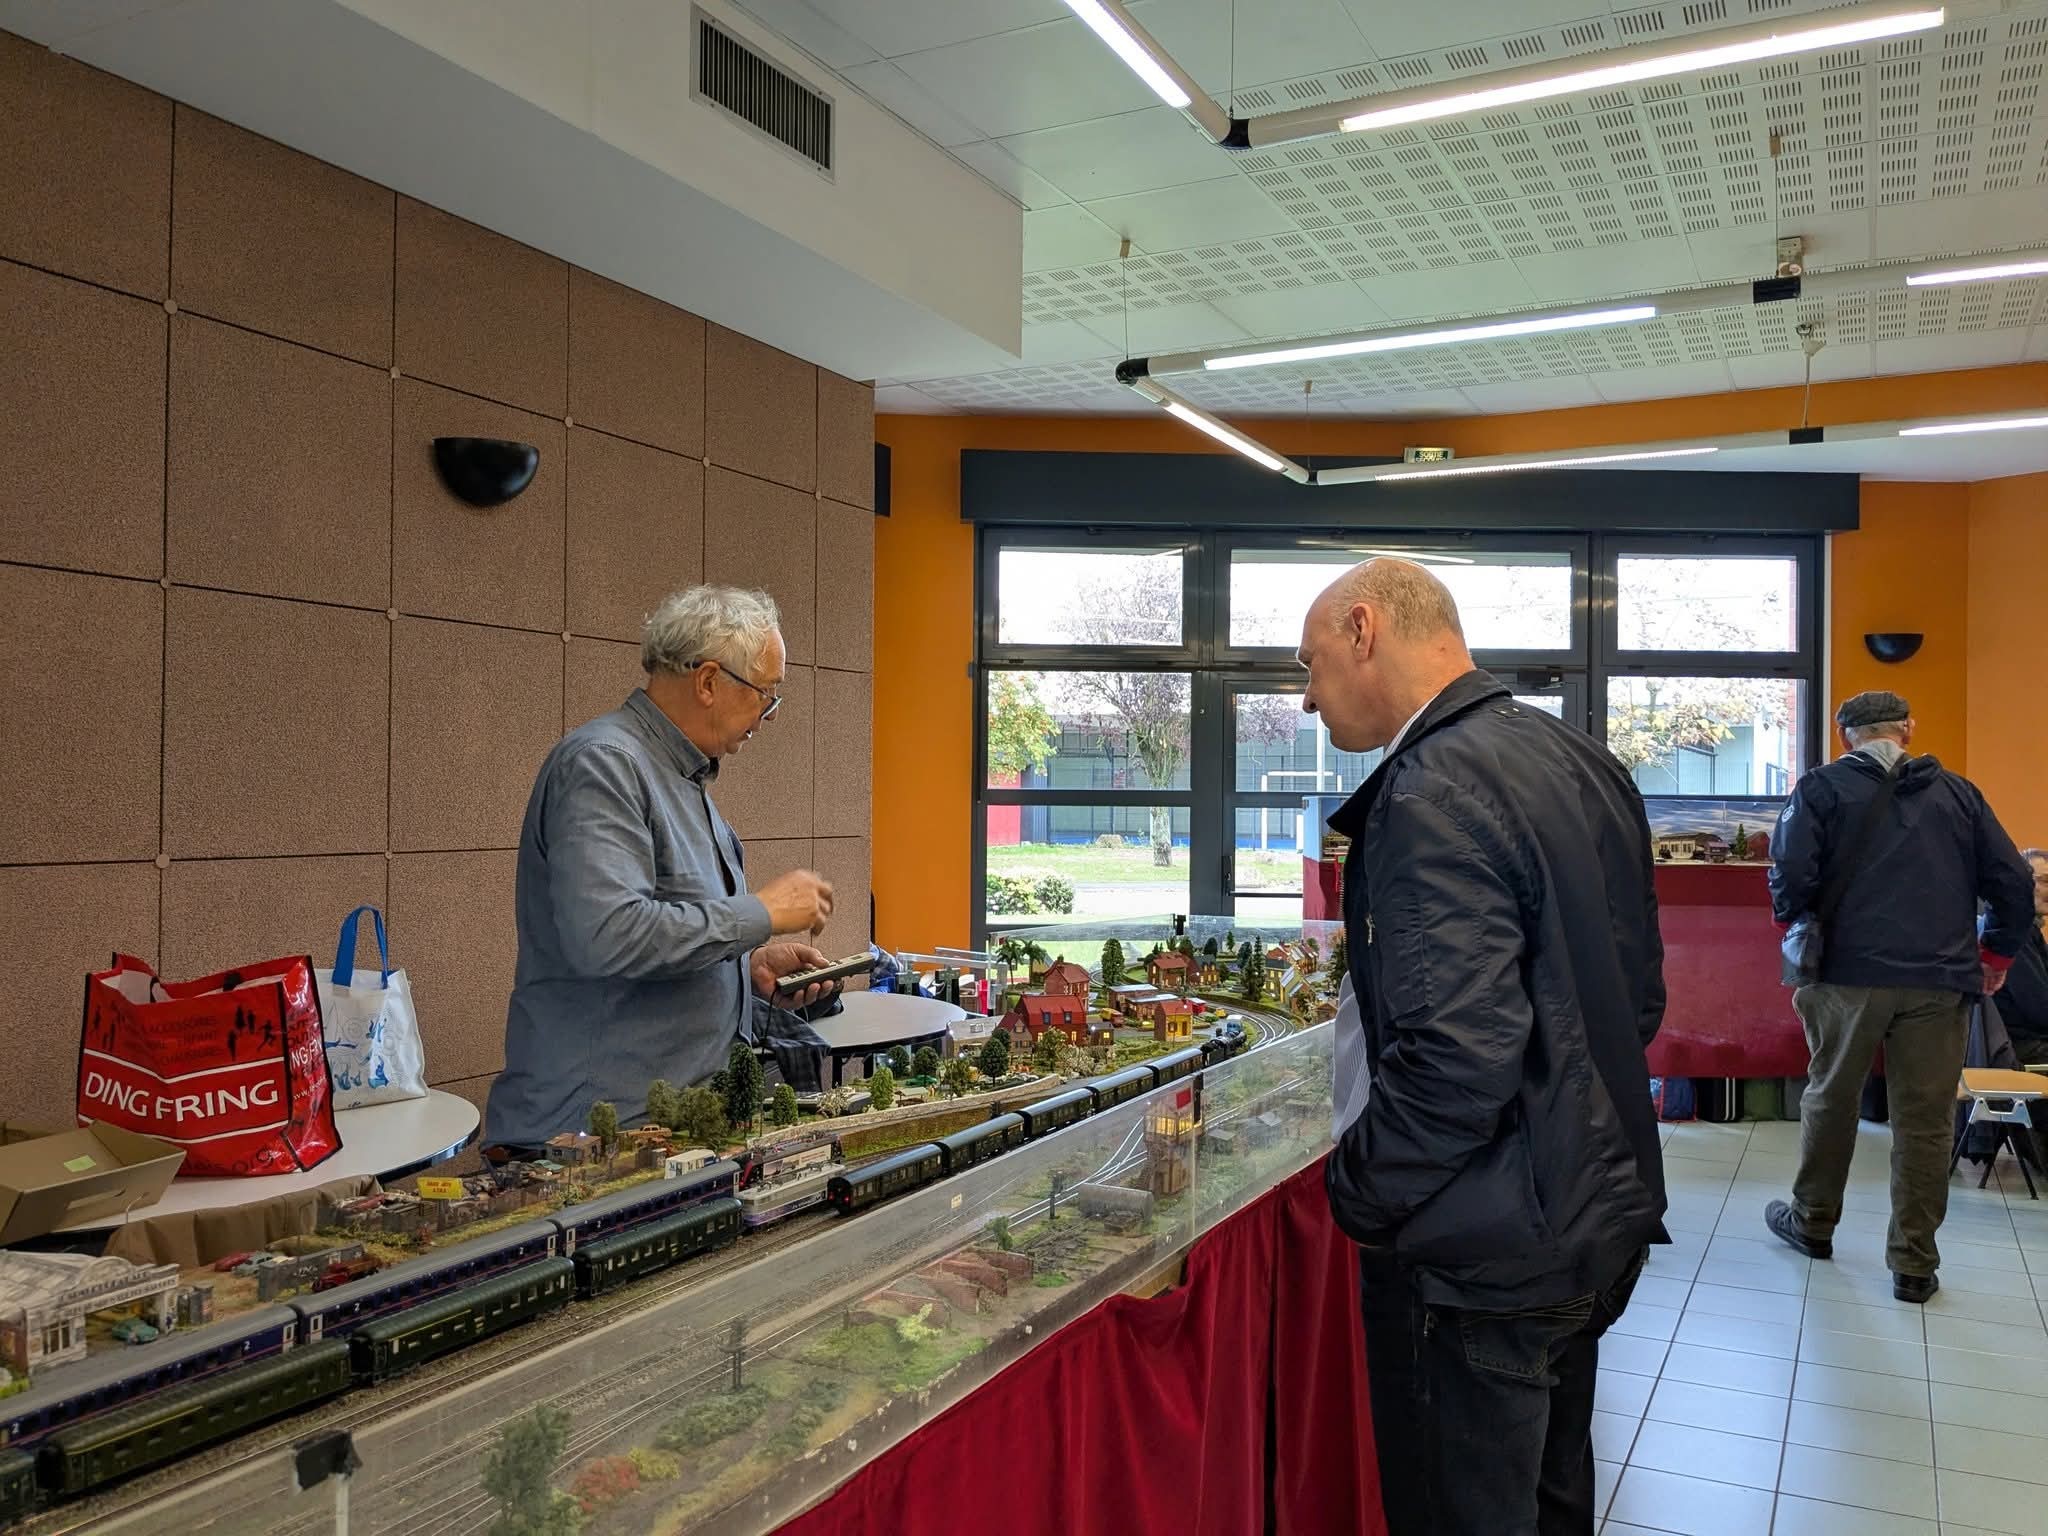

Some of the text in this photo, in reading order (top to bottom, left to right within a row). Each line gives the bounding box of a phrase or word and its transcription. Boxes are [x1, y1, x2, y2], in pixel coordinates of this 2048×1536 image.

[85, 1071, 149, 1118] DING
[155, 1079, 279, 1122] FRING
[243, 1340, 251, 1350] 2
[11, 1422, 20, 1434] 2
